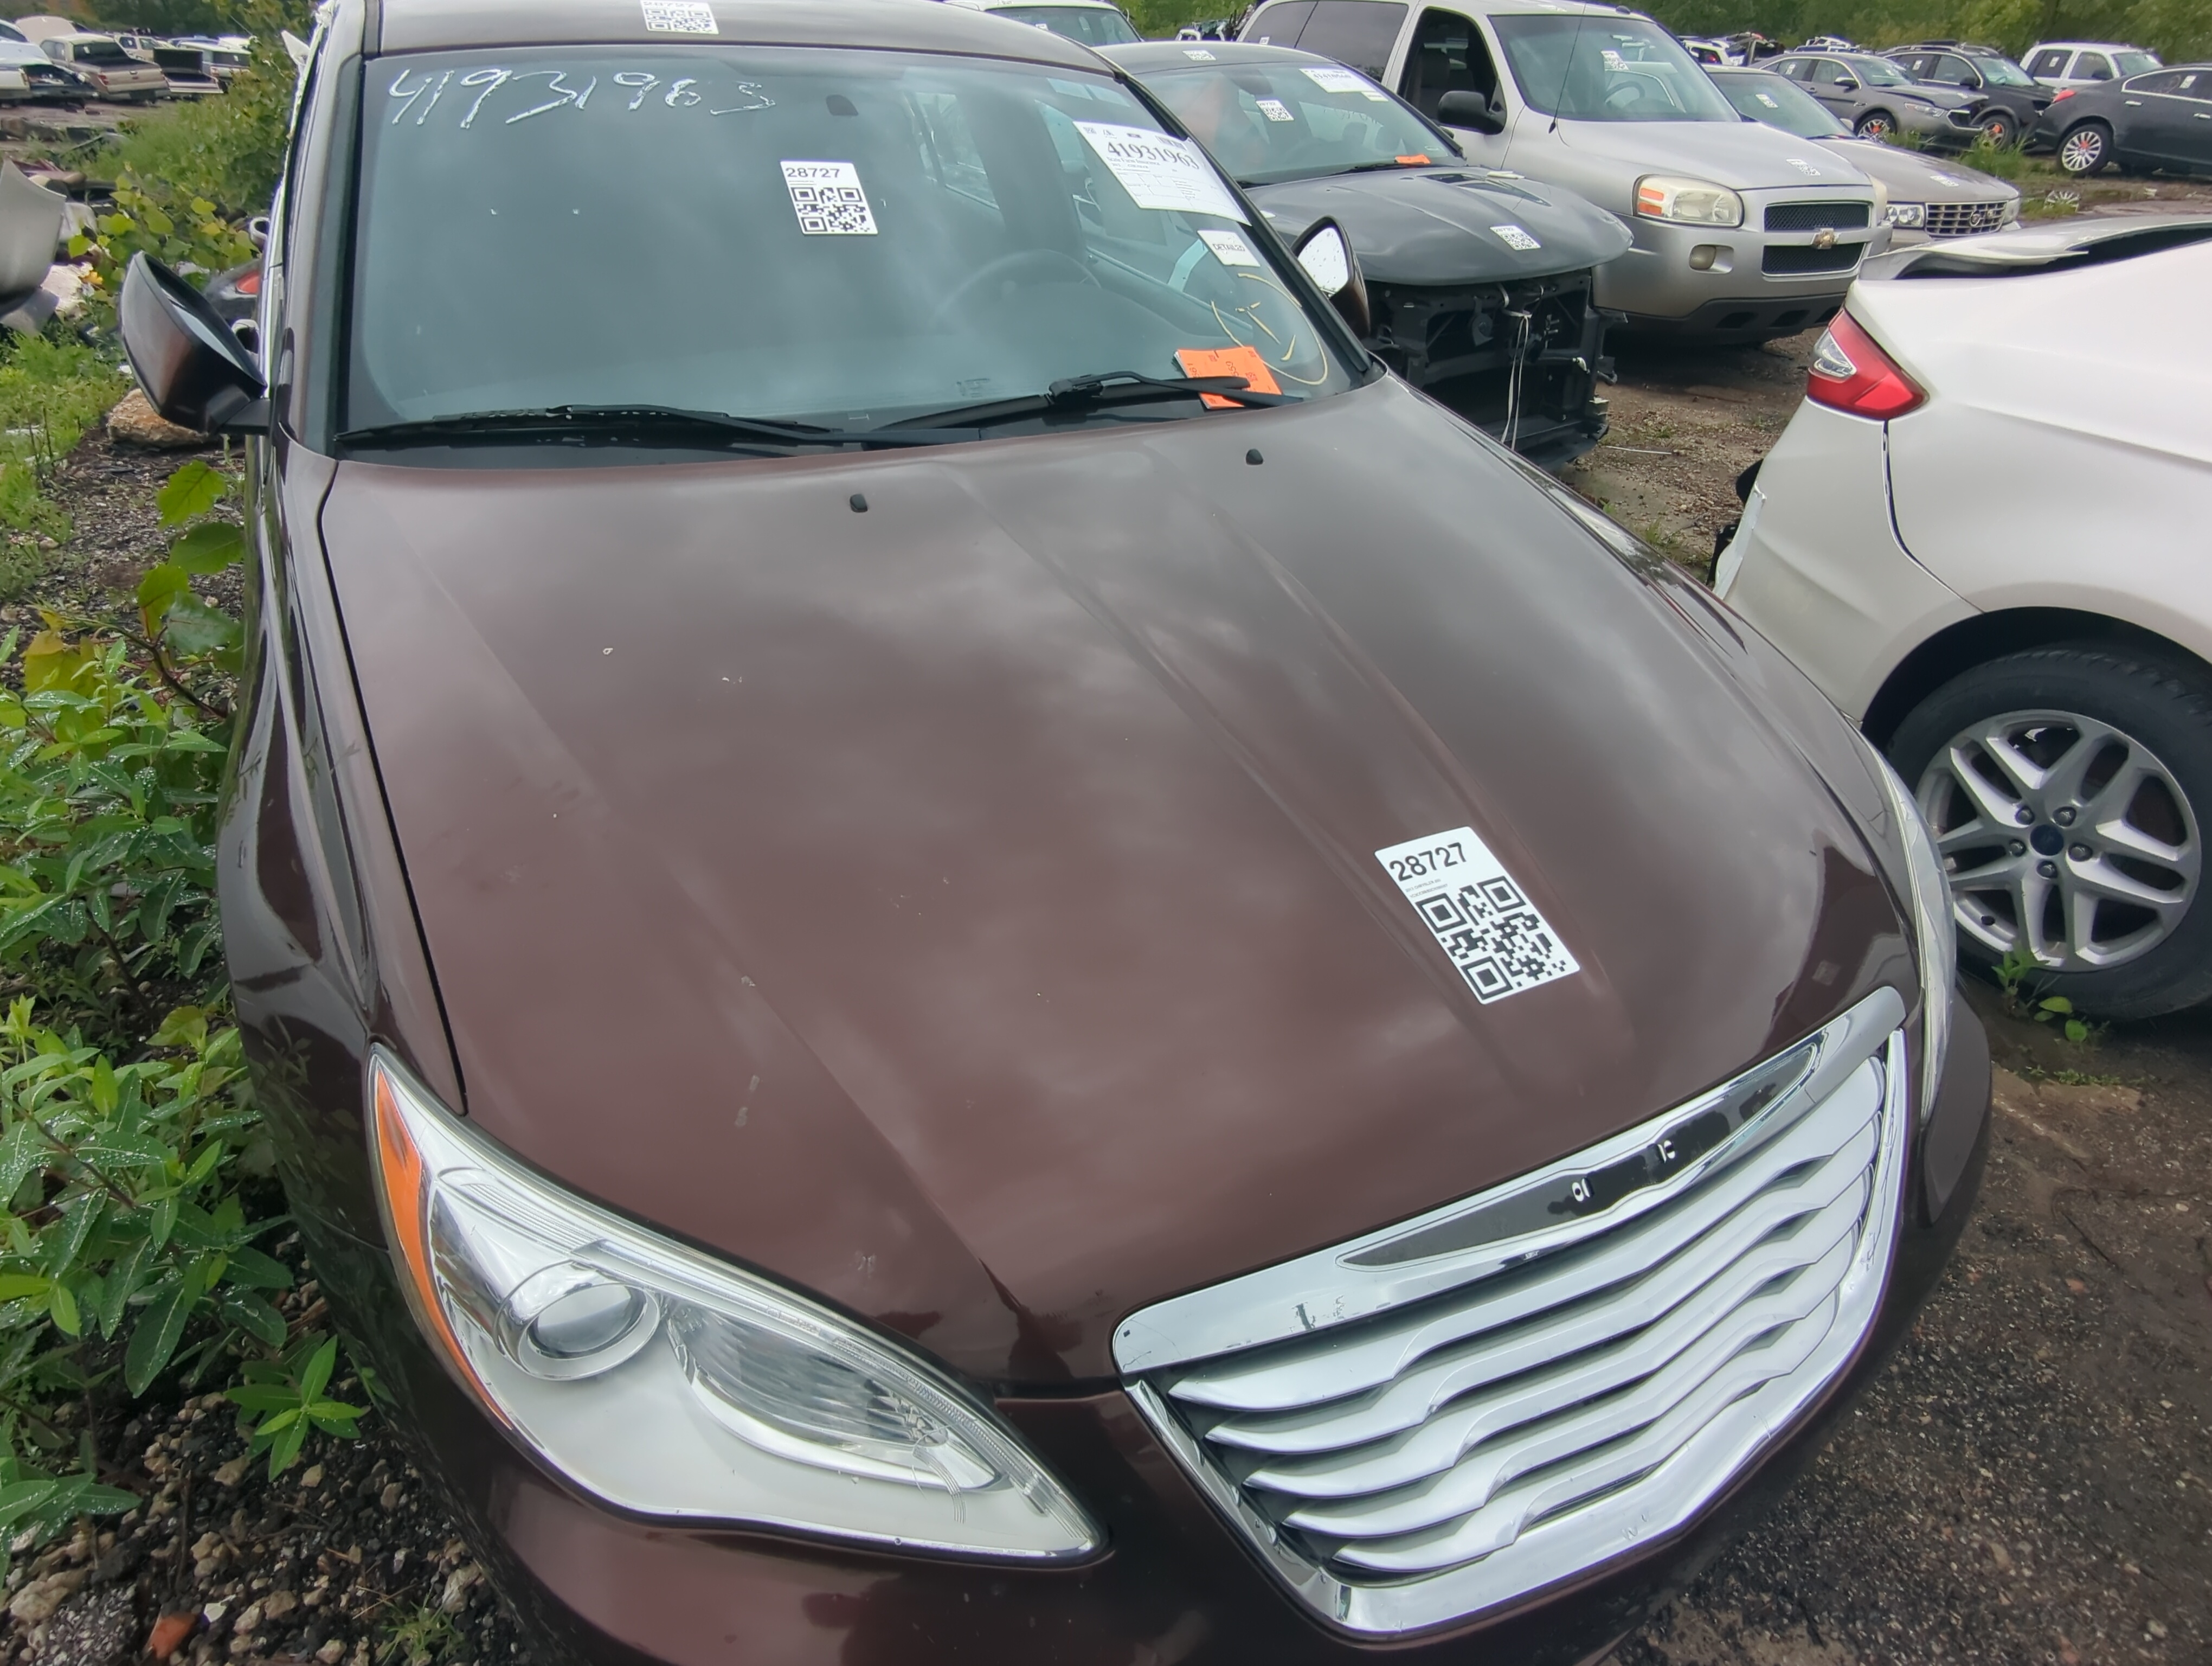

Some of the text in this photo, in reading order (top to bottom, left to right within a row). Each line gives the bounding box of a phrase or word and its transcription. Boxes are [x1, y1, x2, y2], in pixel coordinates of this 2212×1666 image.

[1108, 142, 1200, 170] 41931963
[786, 167, 840, 178] 28727
[1389, 842, 1467, 882] 28727
